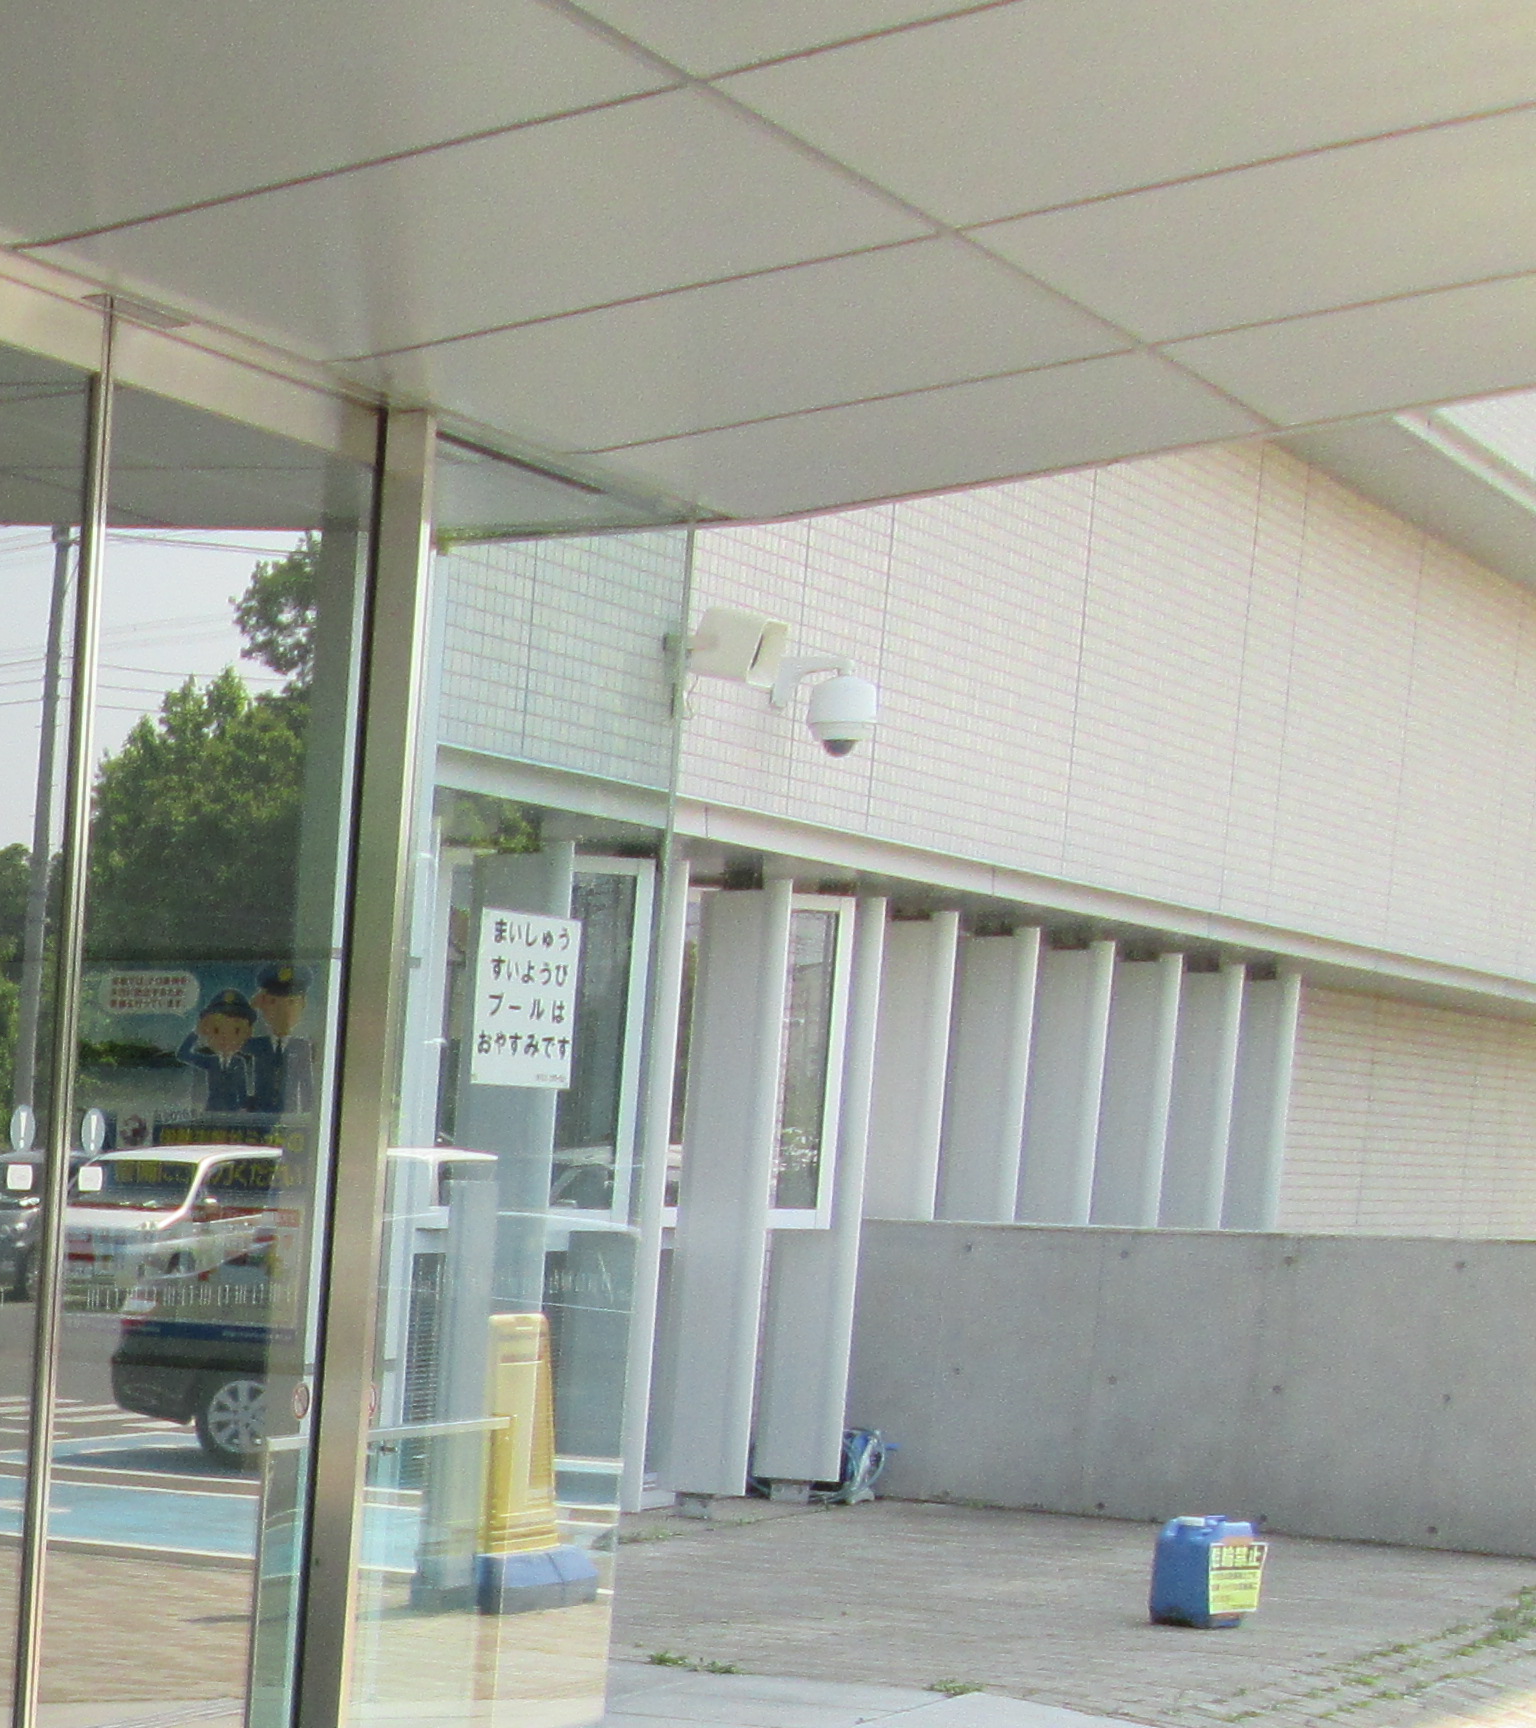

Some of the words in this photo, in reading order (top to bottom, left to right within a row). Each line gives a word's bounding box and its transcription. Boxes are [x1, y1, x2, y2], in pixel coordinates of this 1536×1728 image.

[494, 918, 570, 950] まいしゅう
[491, 956, 568, 987] すいようび
[478, 1029, 570, 1060] おやすみです
